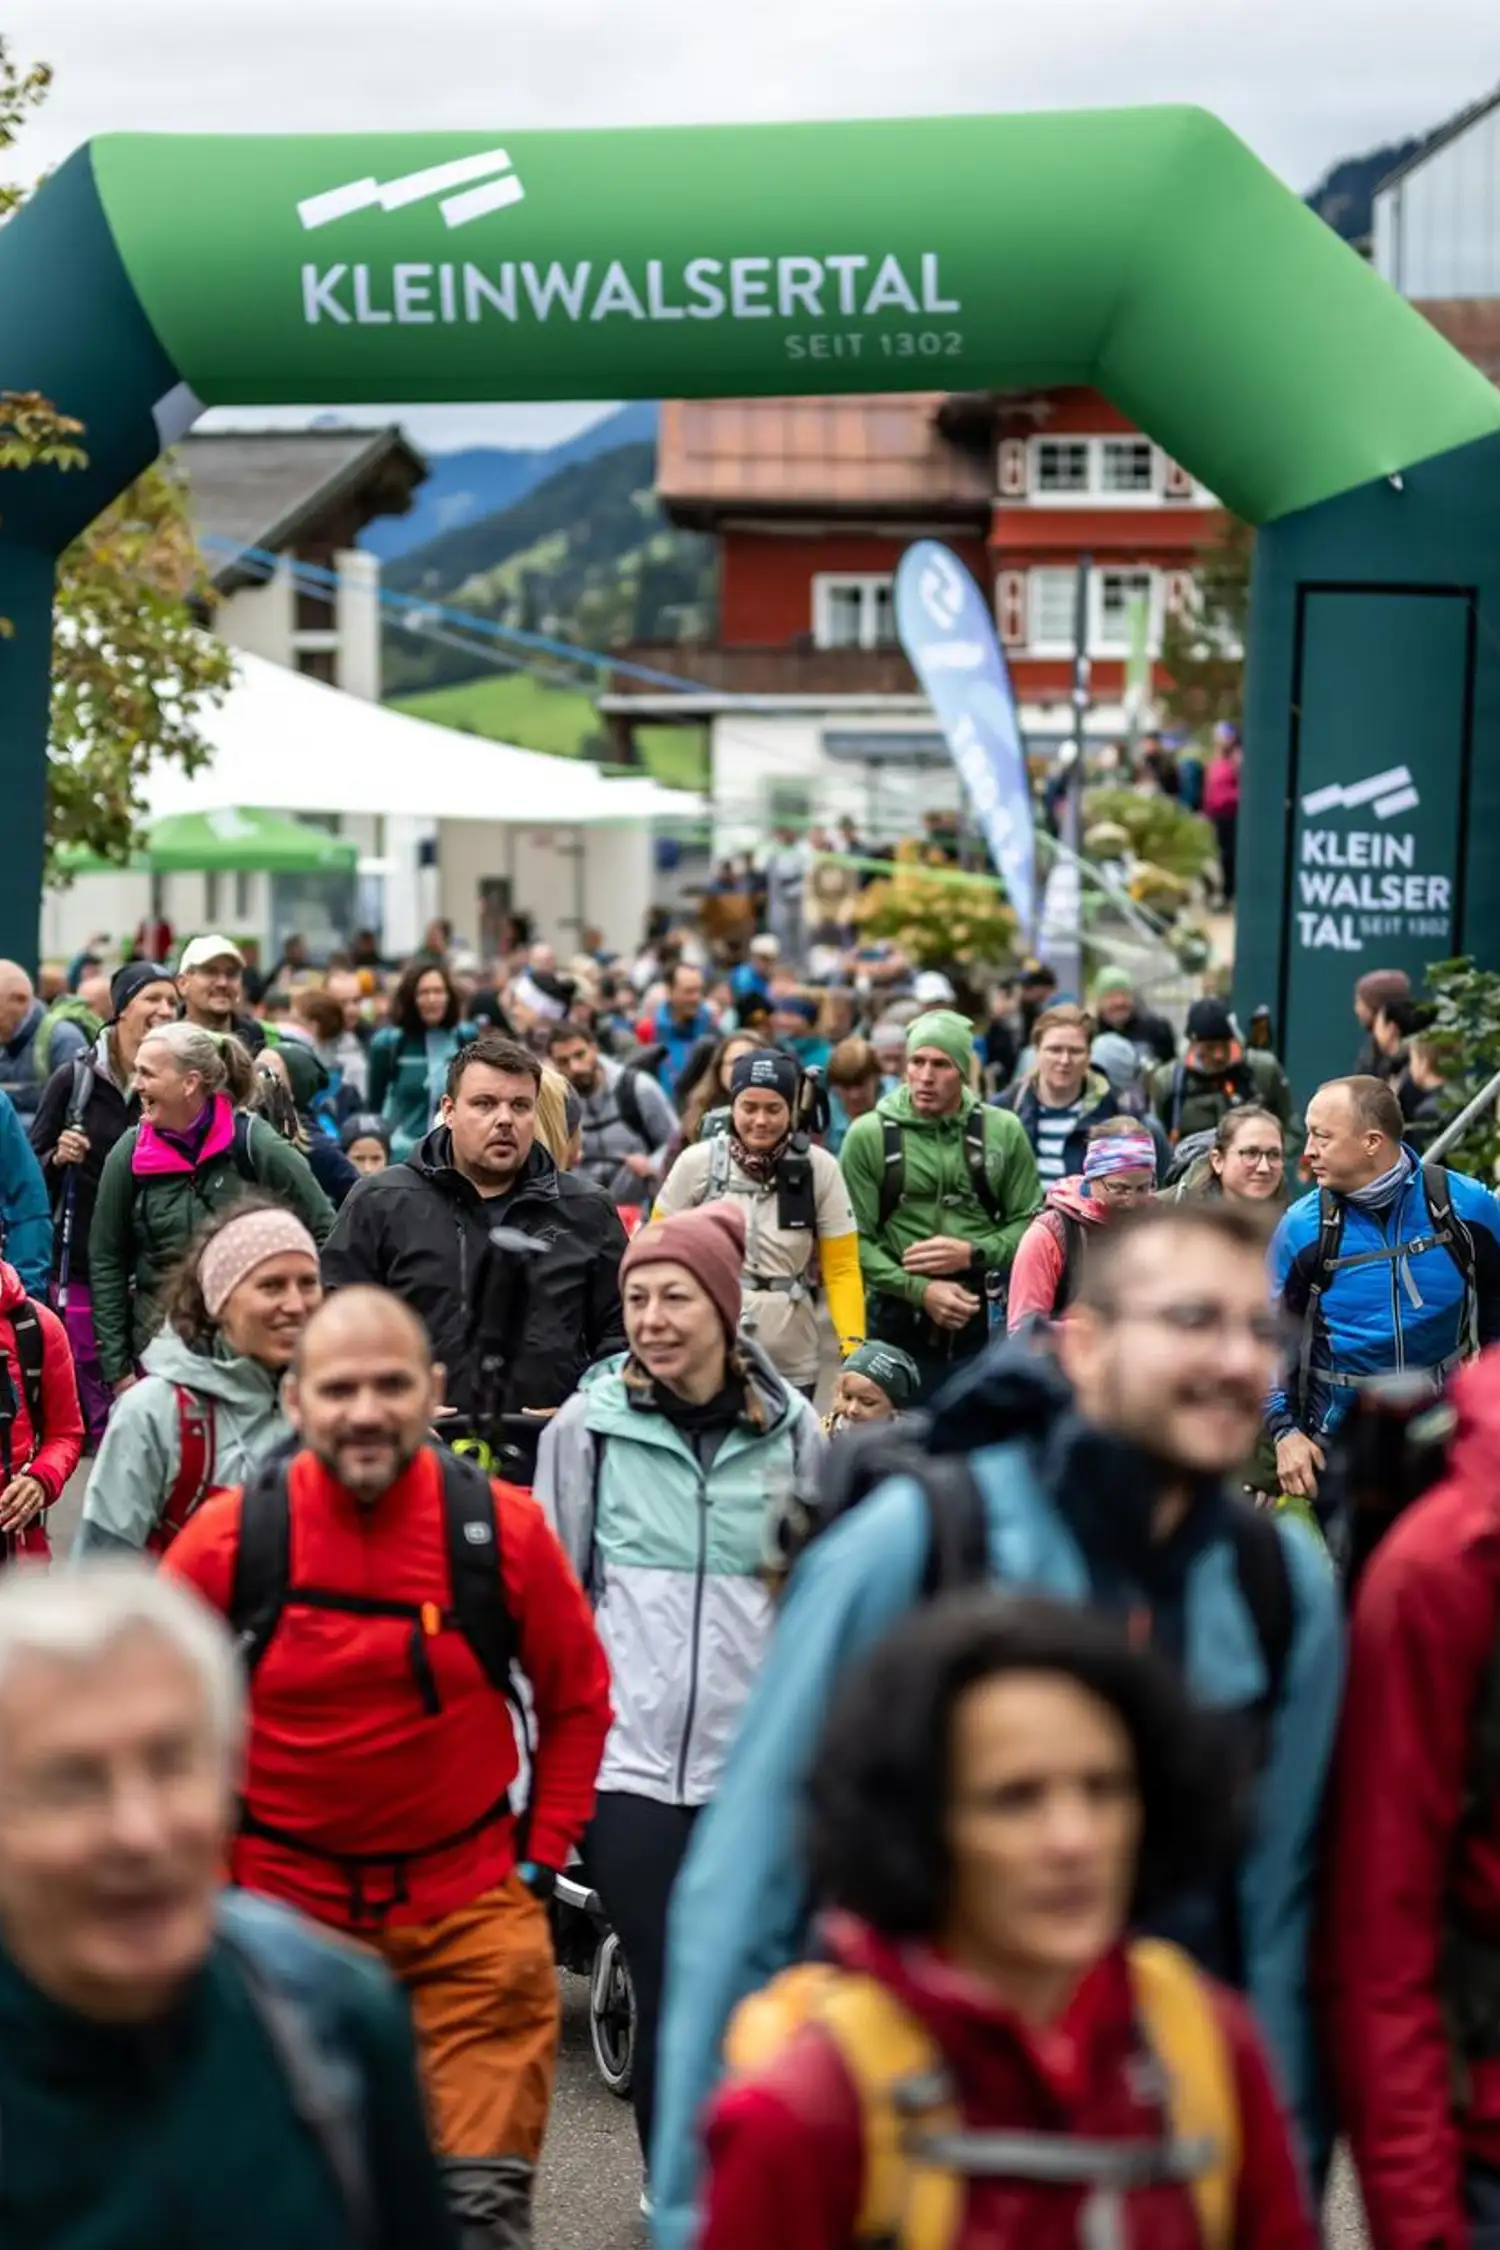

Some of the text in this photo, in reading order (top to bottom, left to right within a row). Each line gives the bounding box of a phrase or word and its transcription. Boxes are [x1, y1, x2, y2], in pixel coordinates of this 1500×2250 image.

[301, 253, 961, 324] KLEINWALSERTAL
[784, 332, 963, 359] SEIT 1302
[1302, 830, 1414, 869] KLEIN
[1299, 870, 1451, 911] WALSER
[1297, 912, 1363, 951] TAL
[1360, 915, 1403, 936] SEIT
